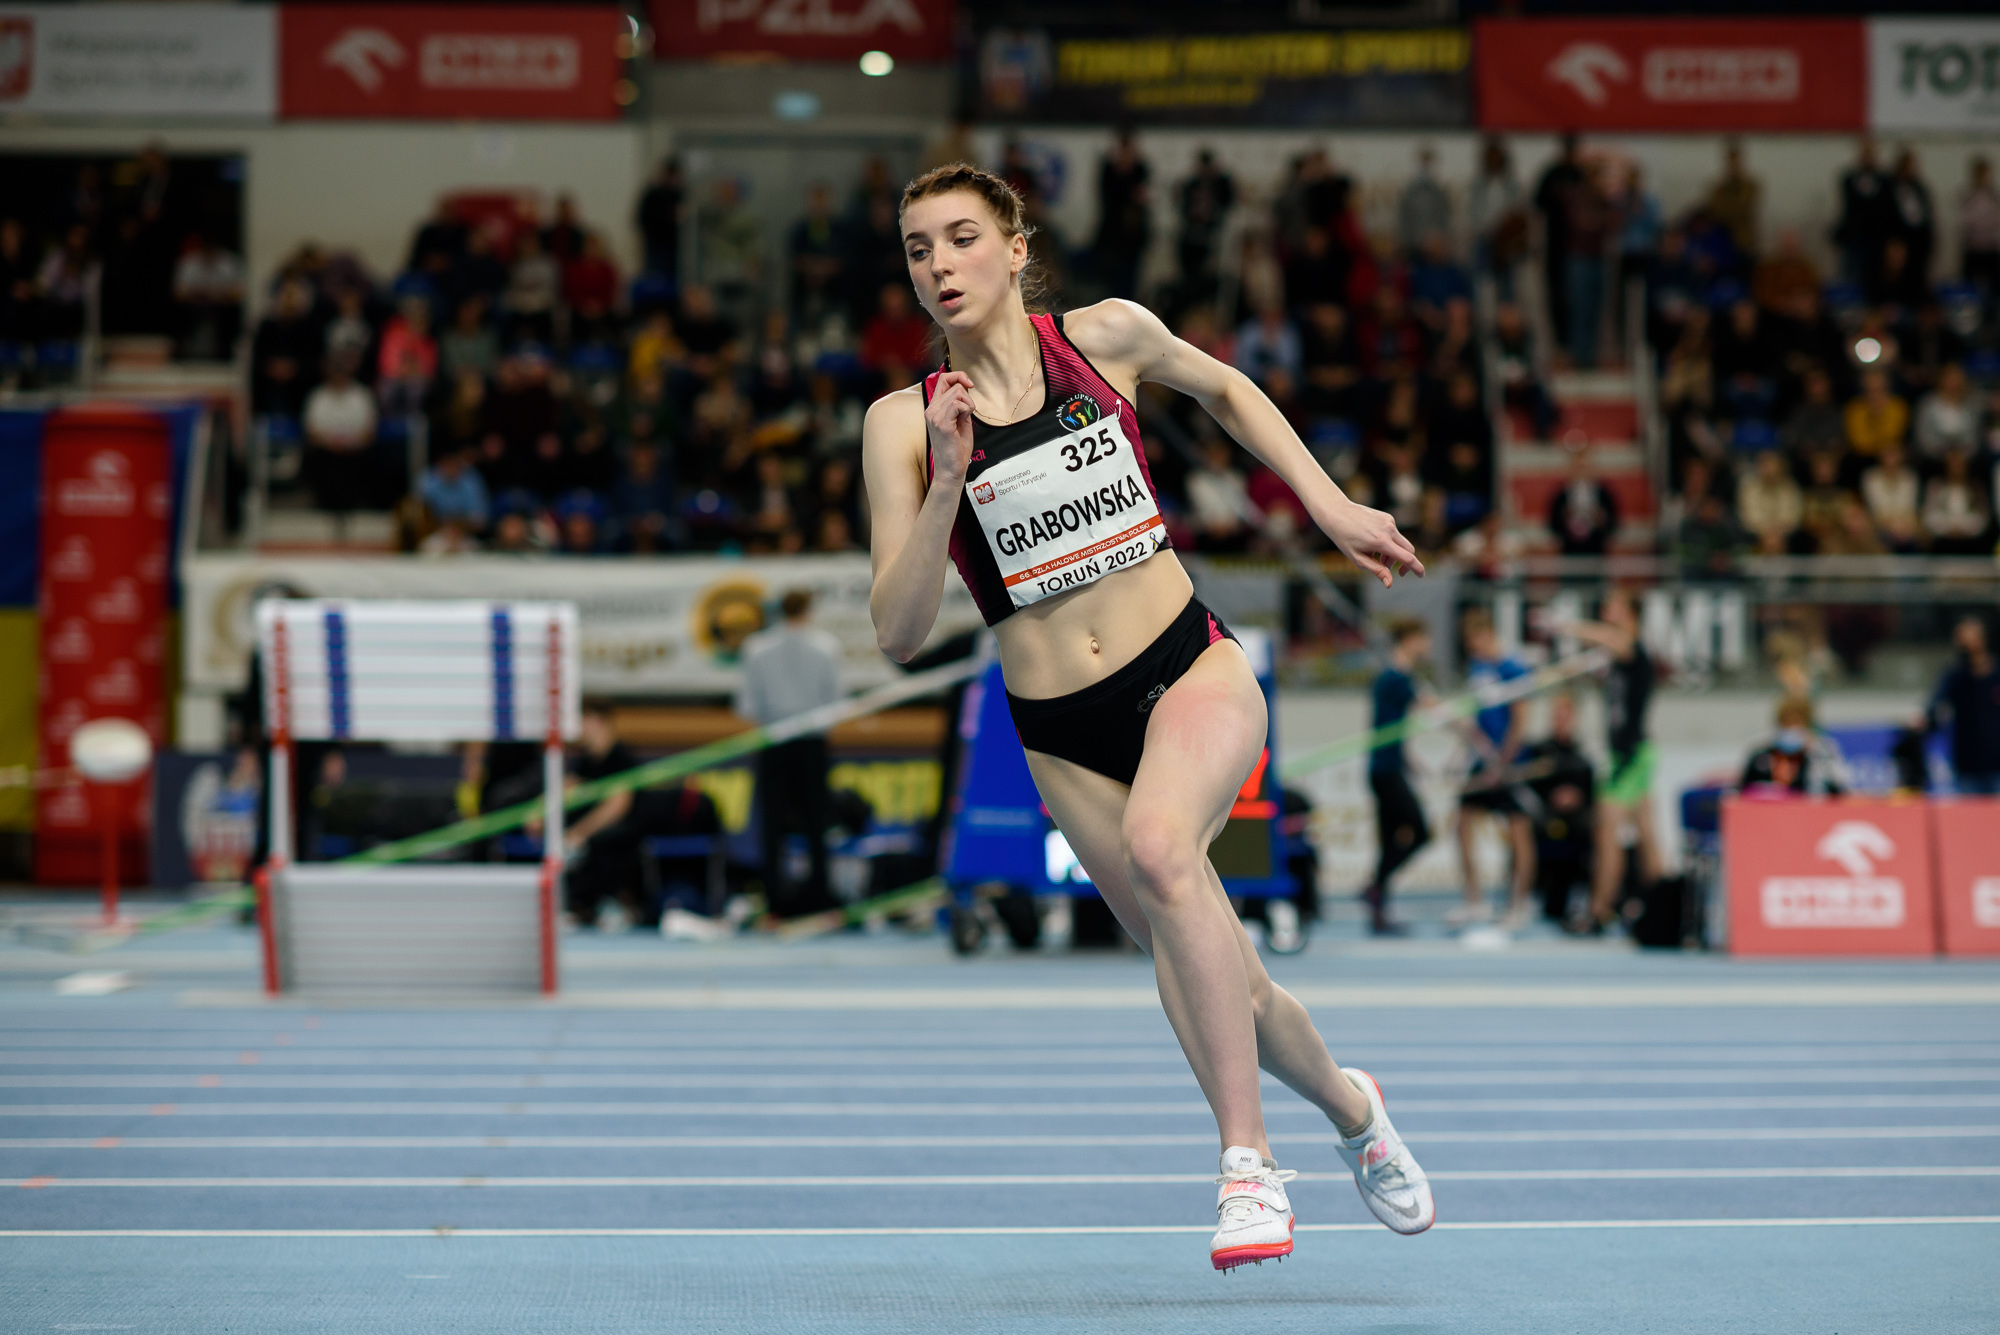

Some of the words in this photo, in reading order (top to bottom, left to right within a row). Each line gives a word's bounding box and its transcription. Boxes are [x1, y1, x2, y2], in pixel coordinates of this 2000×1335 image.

[1060, 428, 1117, 472] 325
[994, 469, 1032, 488] Ministerstwo
[998, 483, 1019, 496] Sportu
[1021, 471, 1048, 487] Turystyki
[995, 474, 1147, 557] GRABOWSKA
[1032, 565, 1051, 576] PZLA
[1051, 553, 1080, 569] HALOWE
[1080, 534, 1129, 558] MISTRZOSTWA
[1128, 523, 1151, 538] POLSKI
[1037, 557, 1101, 595] TORUŃ
[1104, 541, 1148, 570] 2022
[1221, 1180, 1264, 1199] NIKE
